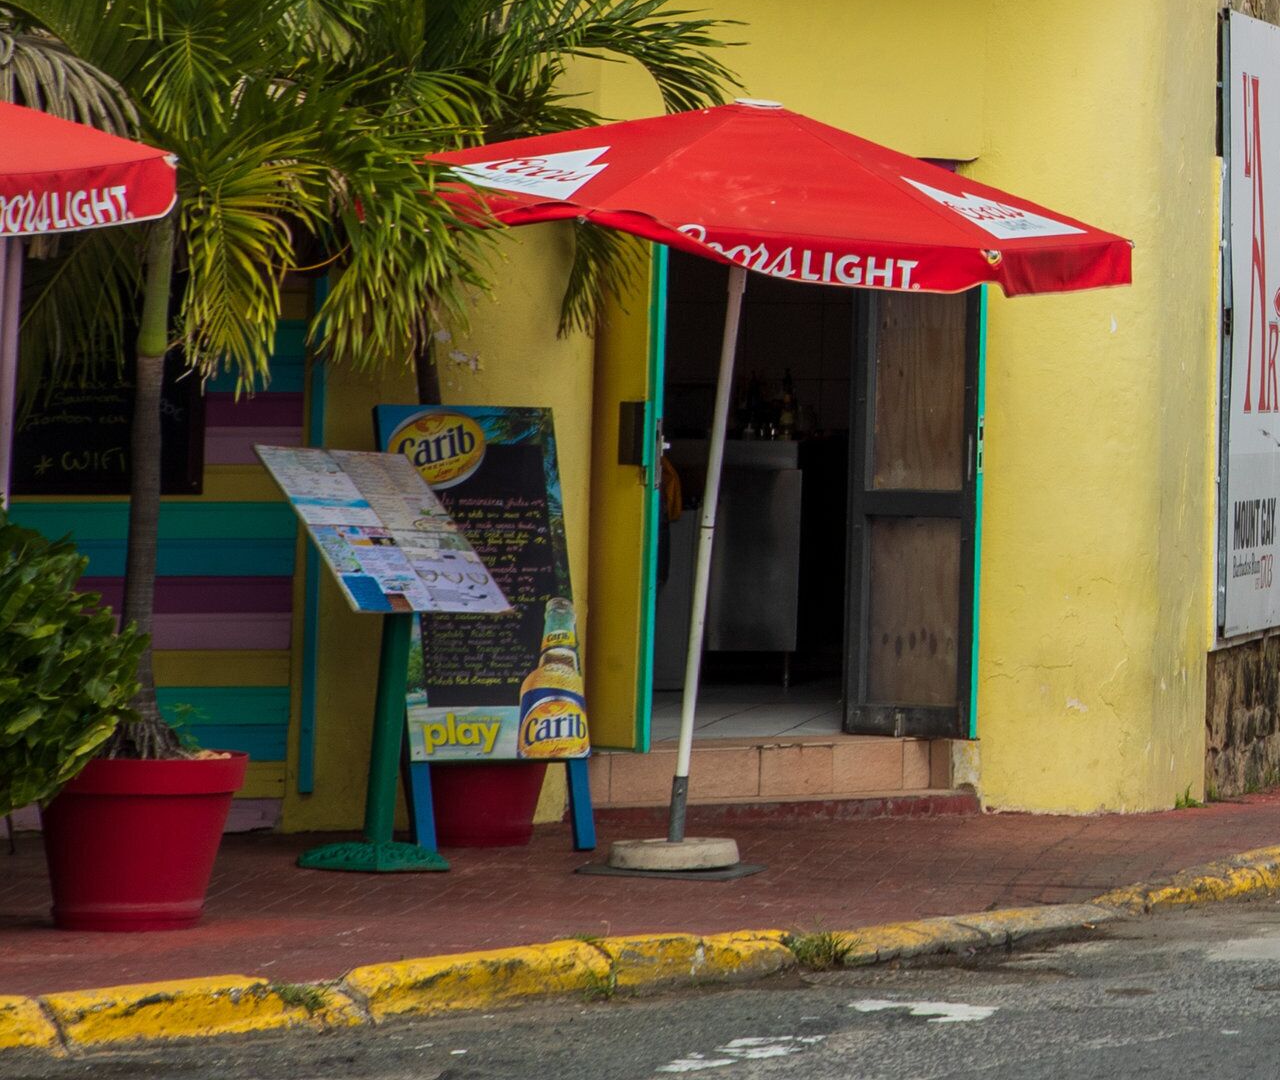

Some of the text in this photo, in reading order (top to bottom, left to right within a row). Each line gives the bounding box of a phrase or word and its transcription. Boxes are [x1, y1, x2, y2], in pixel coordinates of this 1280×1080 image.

[51, 185, 126, 228] LIGHT
[801, 249, 919, 290] LIGHT
[1233, 497, 1277, 550] MOUNT GAY
[422, 711, 500, 755] play
[525, 714, 586, 746] Carib
